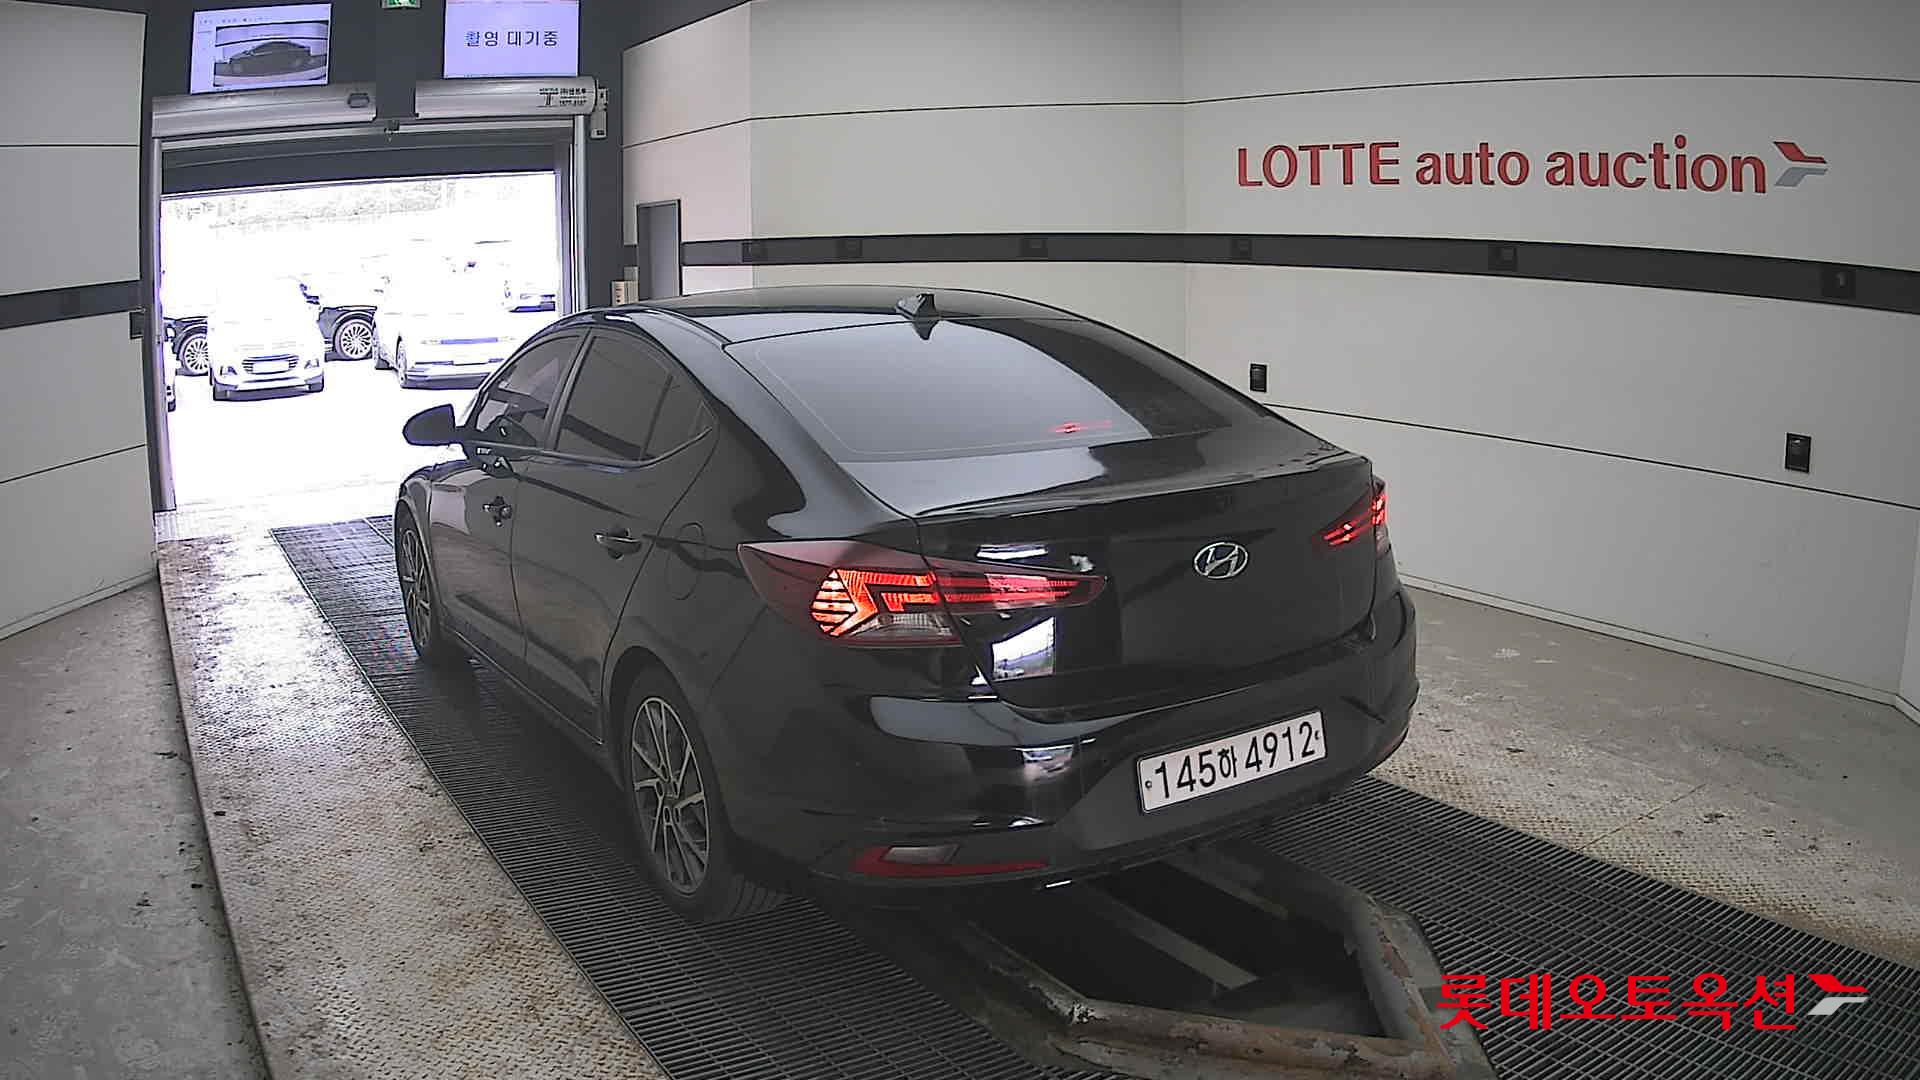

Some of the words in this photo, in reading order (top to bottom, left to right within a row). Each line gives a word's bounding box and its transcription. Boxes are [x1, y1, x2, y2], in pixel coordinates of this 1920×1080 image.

[507, 31, 558, 47] 대기중
[1237, 141, 1400, 189] LOTTE
[1415, 142, 1530, 187] auto
[1545, 134, 1768, 194] auction
